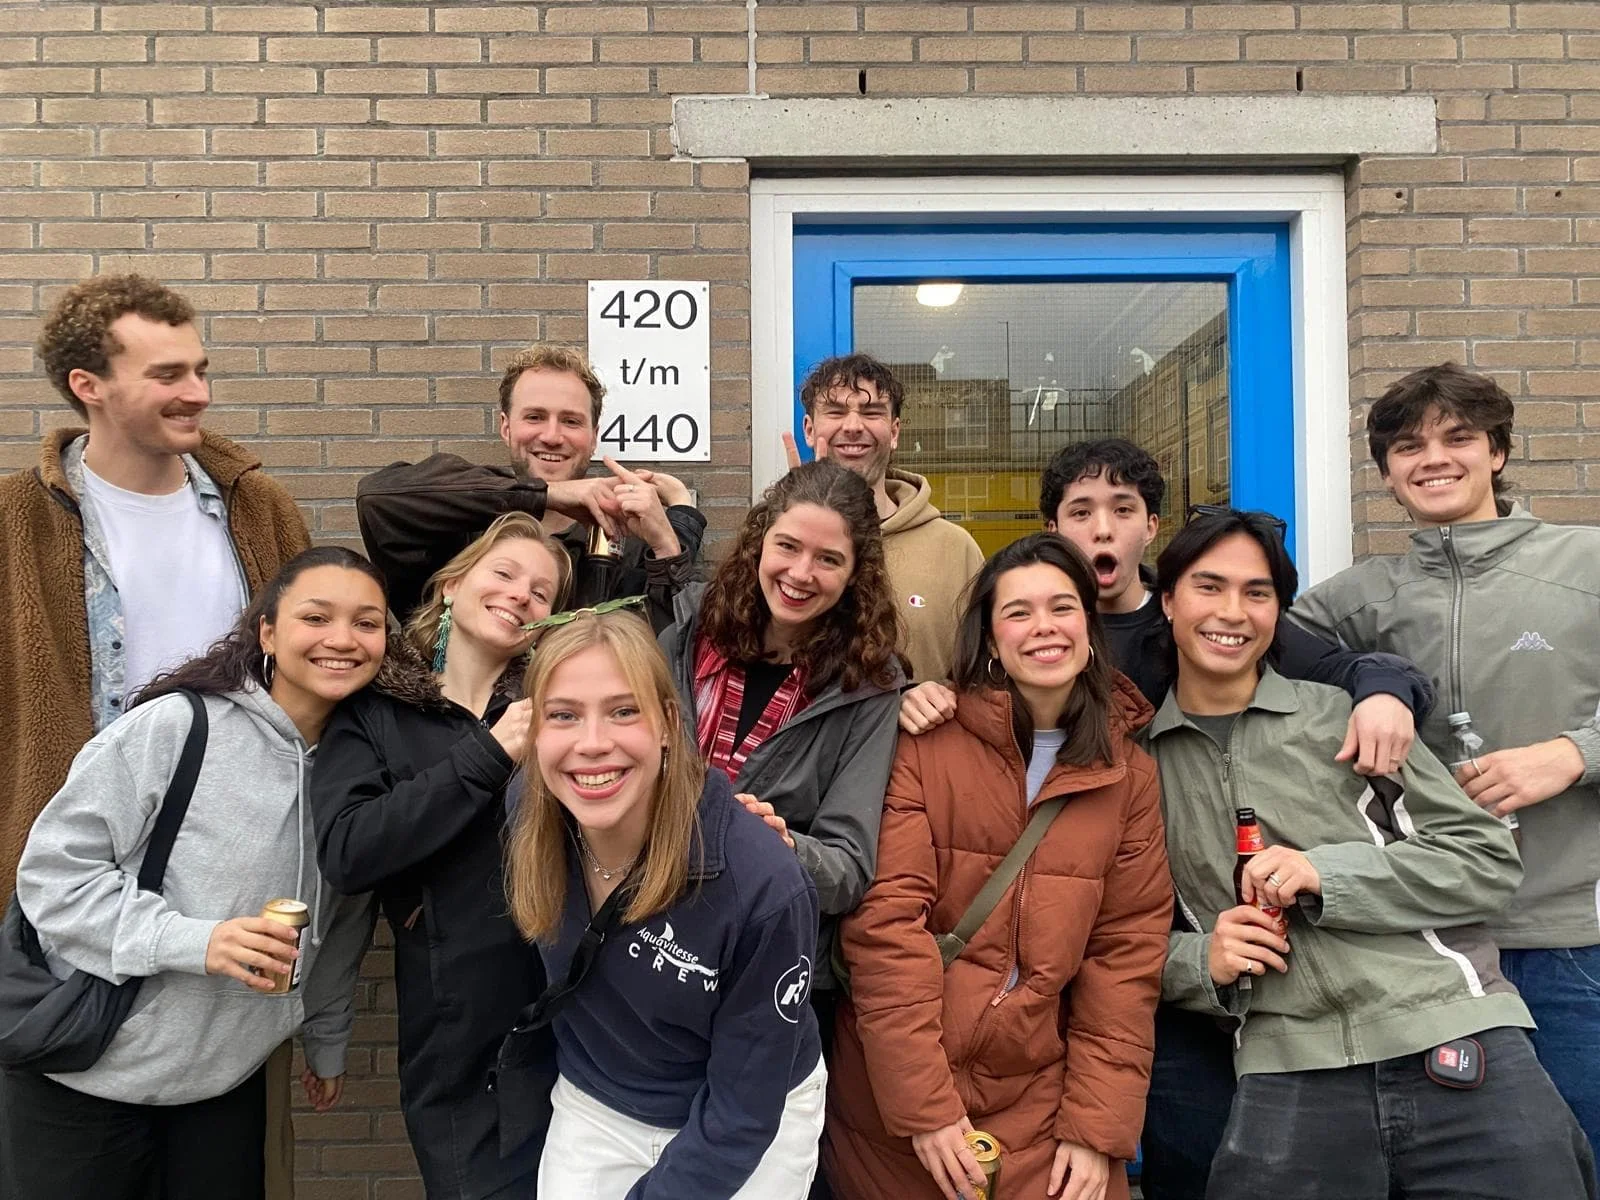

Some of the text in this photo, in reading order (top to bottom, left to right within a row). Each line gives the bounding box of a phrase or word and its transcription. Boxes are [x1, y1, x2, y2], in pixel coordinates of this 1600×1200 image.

[600, 289, 698, 330] 420
[619, 357, 680, 385] t/m
[600, 413, 699, 454] 440
[636, 926, 699, 964] Aquavitesse
